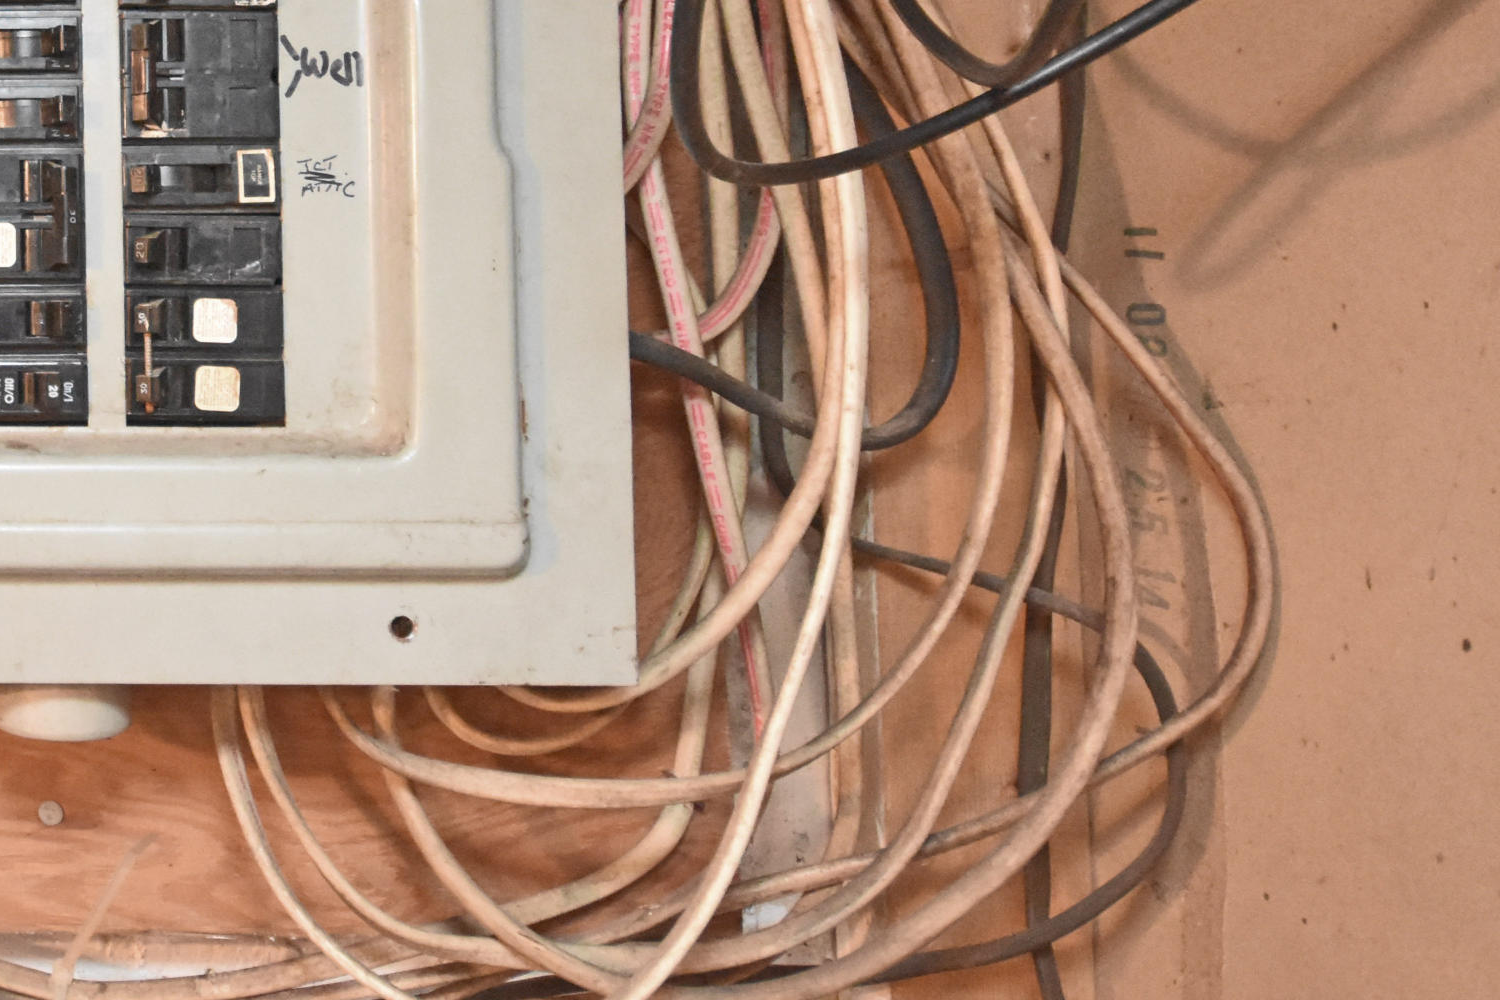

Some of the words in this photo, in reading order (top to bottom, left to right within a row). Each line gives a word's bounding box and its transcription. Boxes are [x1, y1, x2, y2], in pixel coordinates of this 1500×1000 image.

[136, 242, 145, 258] 20
[48, 385, 59, 398] 20
[697, 431, 716, 481] CABLE
